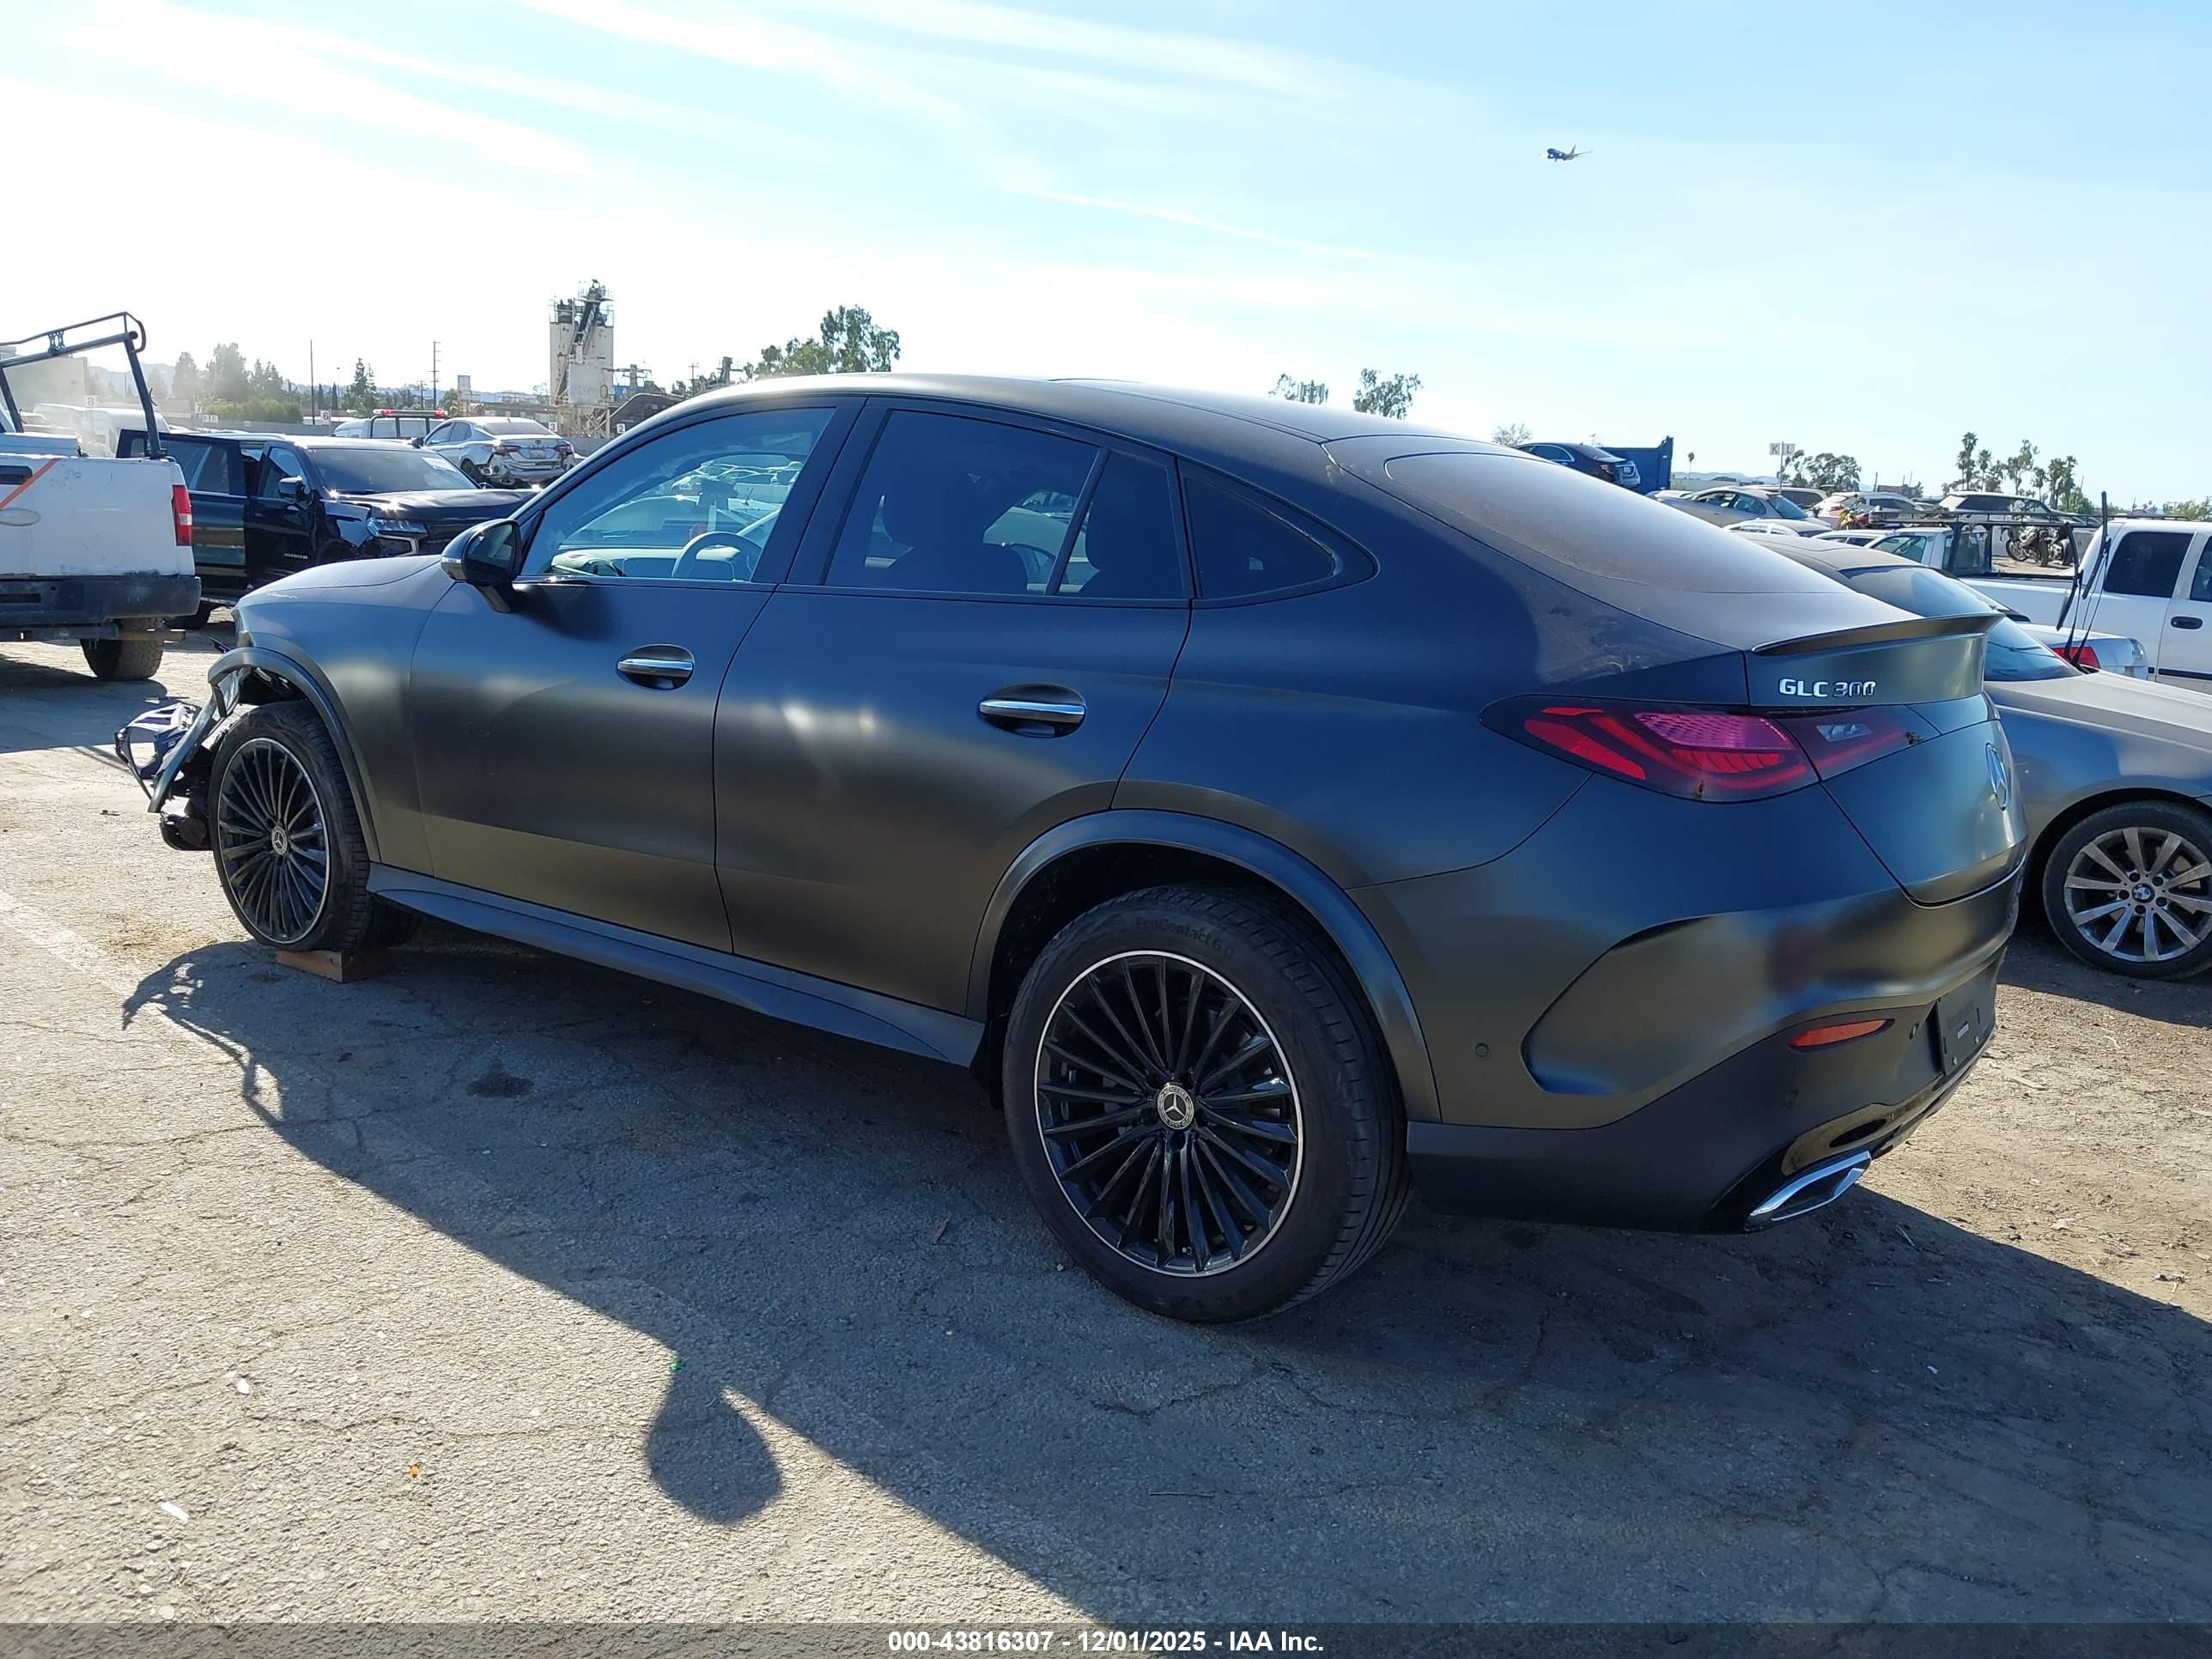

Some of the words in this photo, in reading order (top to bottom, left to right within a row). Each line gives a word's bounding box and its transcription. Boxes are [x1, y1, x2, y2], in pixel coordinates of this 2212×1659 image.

[88, 397, 95, 406] 8
[197, 403, 204, 412] 7
[323, 411, 329, 421] 6
[1771, 444, 1778, 454] K
[1786, 444, 1792, 454] L
[1779, 678, 1829, 697] GLC
[1833, 681, 1876, 697] 300
[1136, 916, 1212, 947] EcoContact
[1212, 937, 1222, 951] 6
